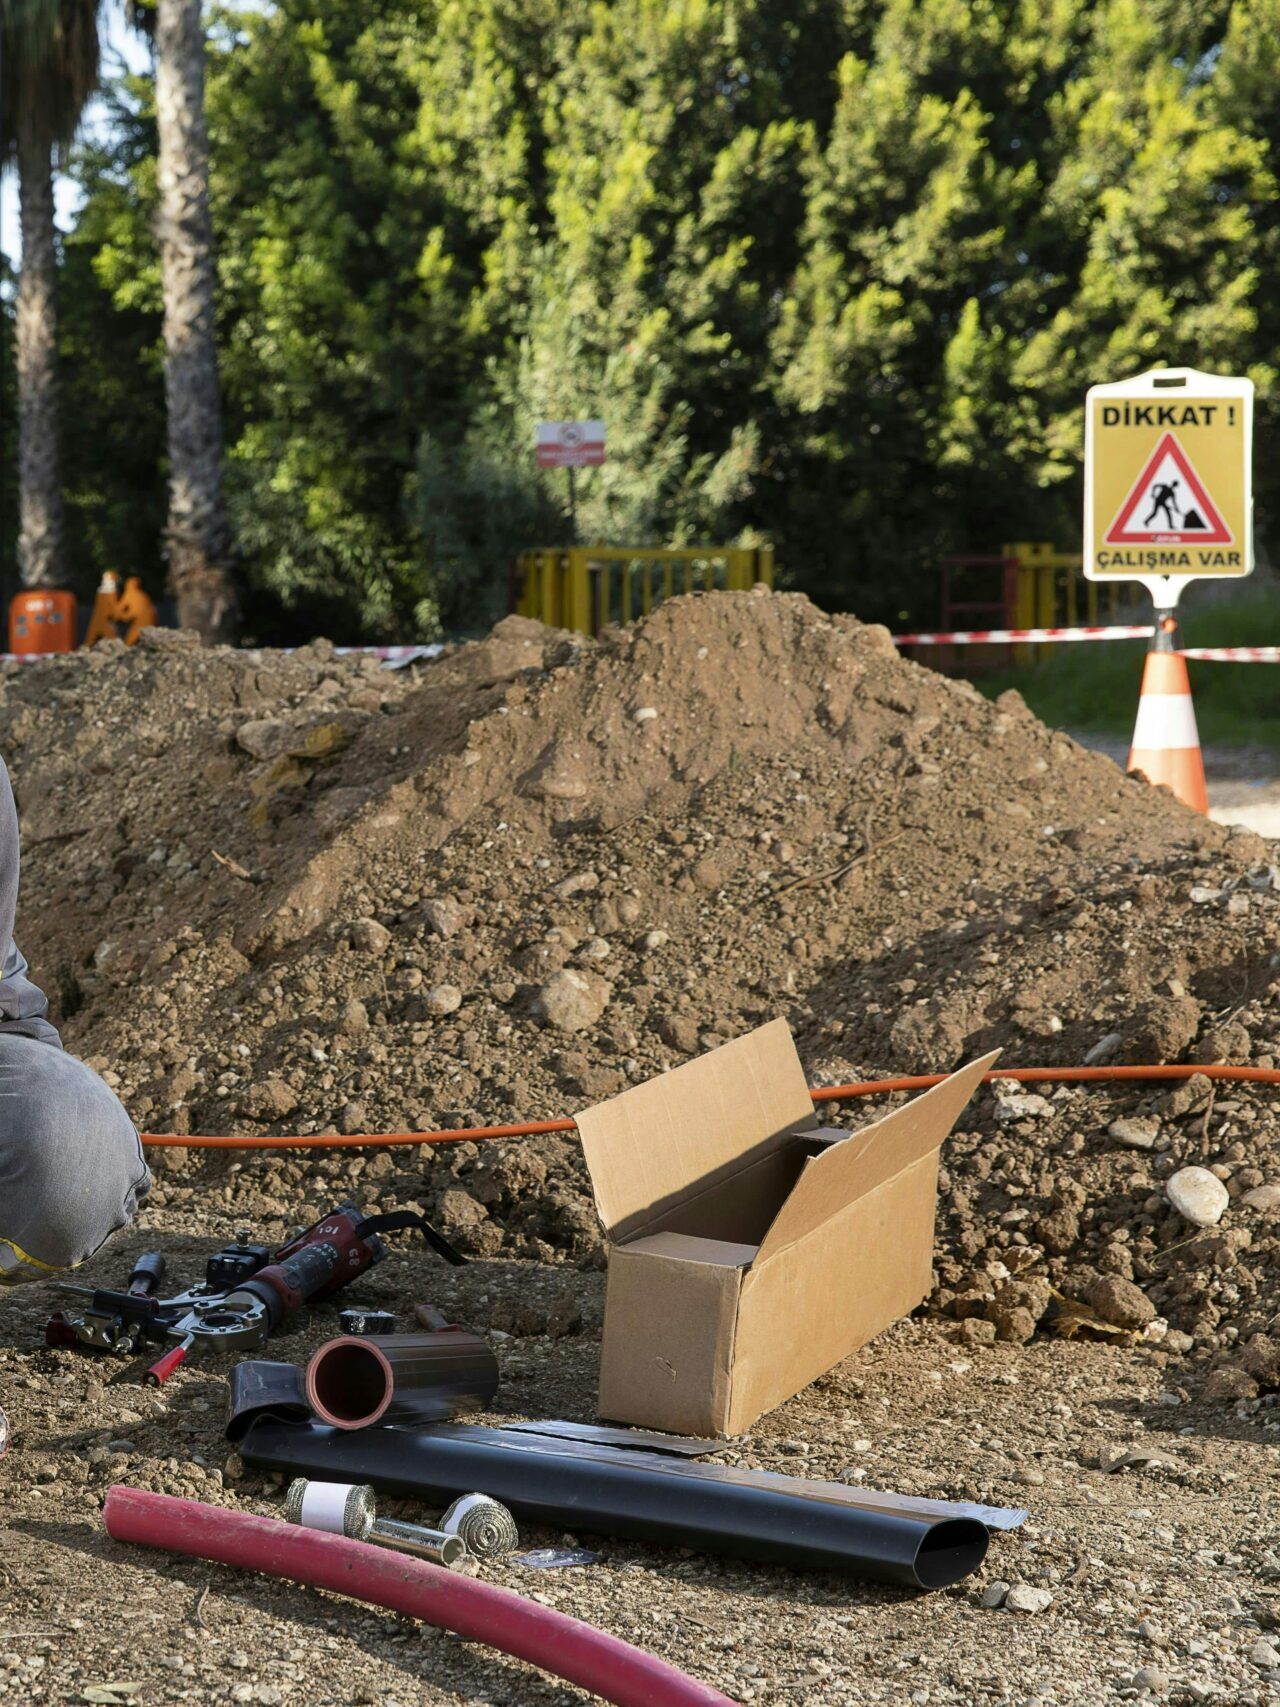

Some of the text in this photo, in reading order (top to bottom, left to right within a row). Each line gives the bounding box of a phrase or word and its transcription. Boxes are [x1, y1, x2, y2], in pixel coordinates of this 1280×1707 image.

[1102, 402, 1217, 426] DİKKAT
[1097, 551, 1240, 569] ÇALIŞMA VAR
